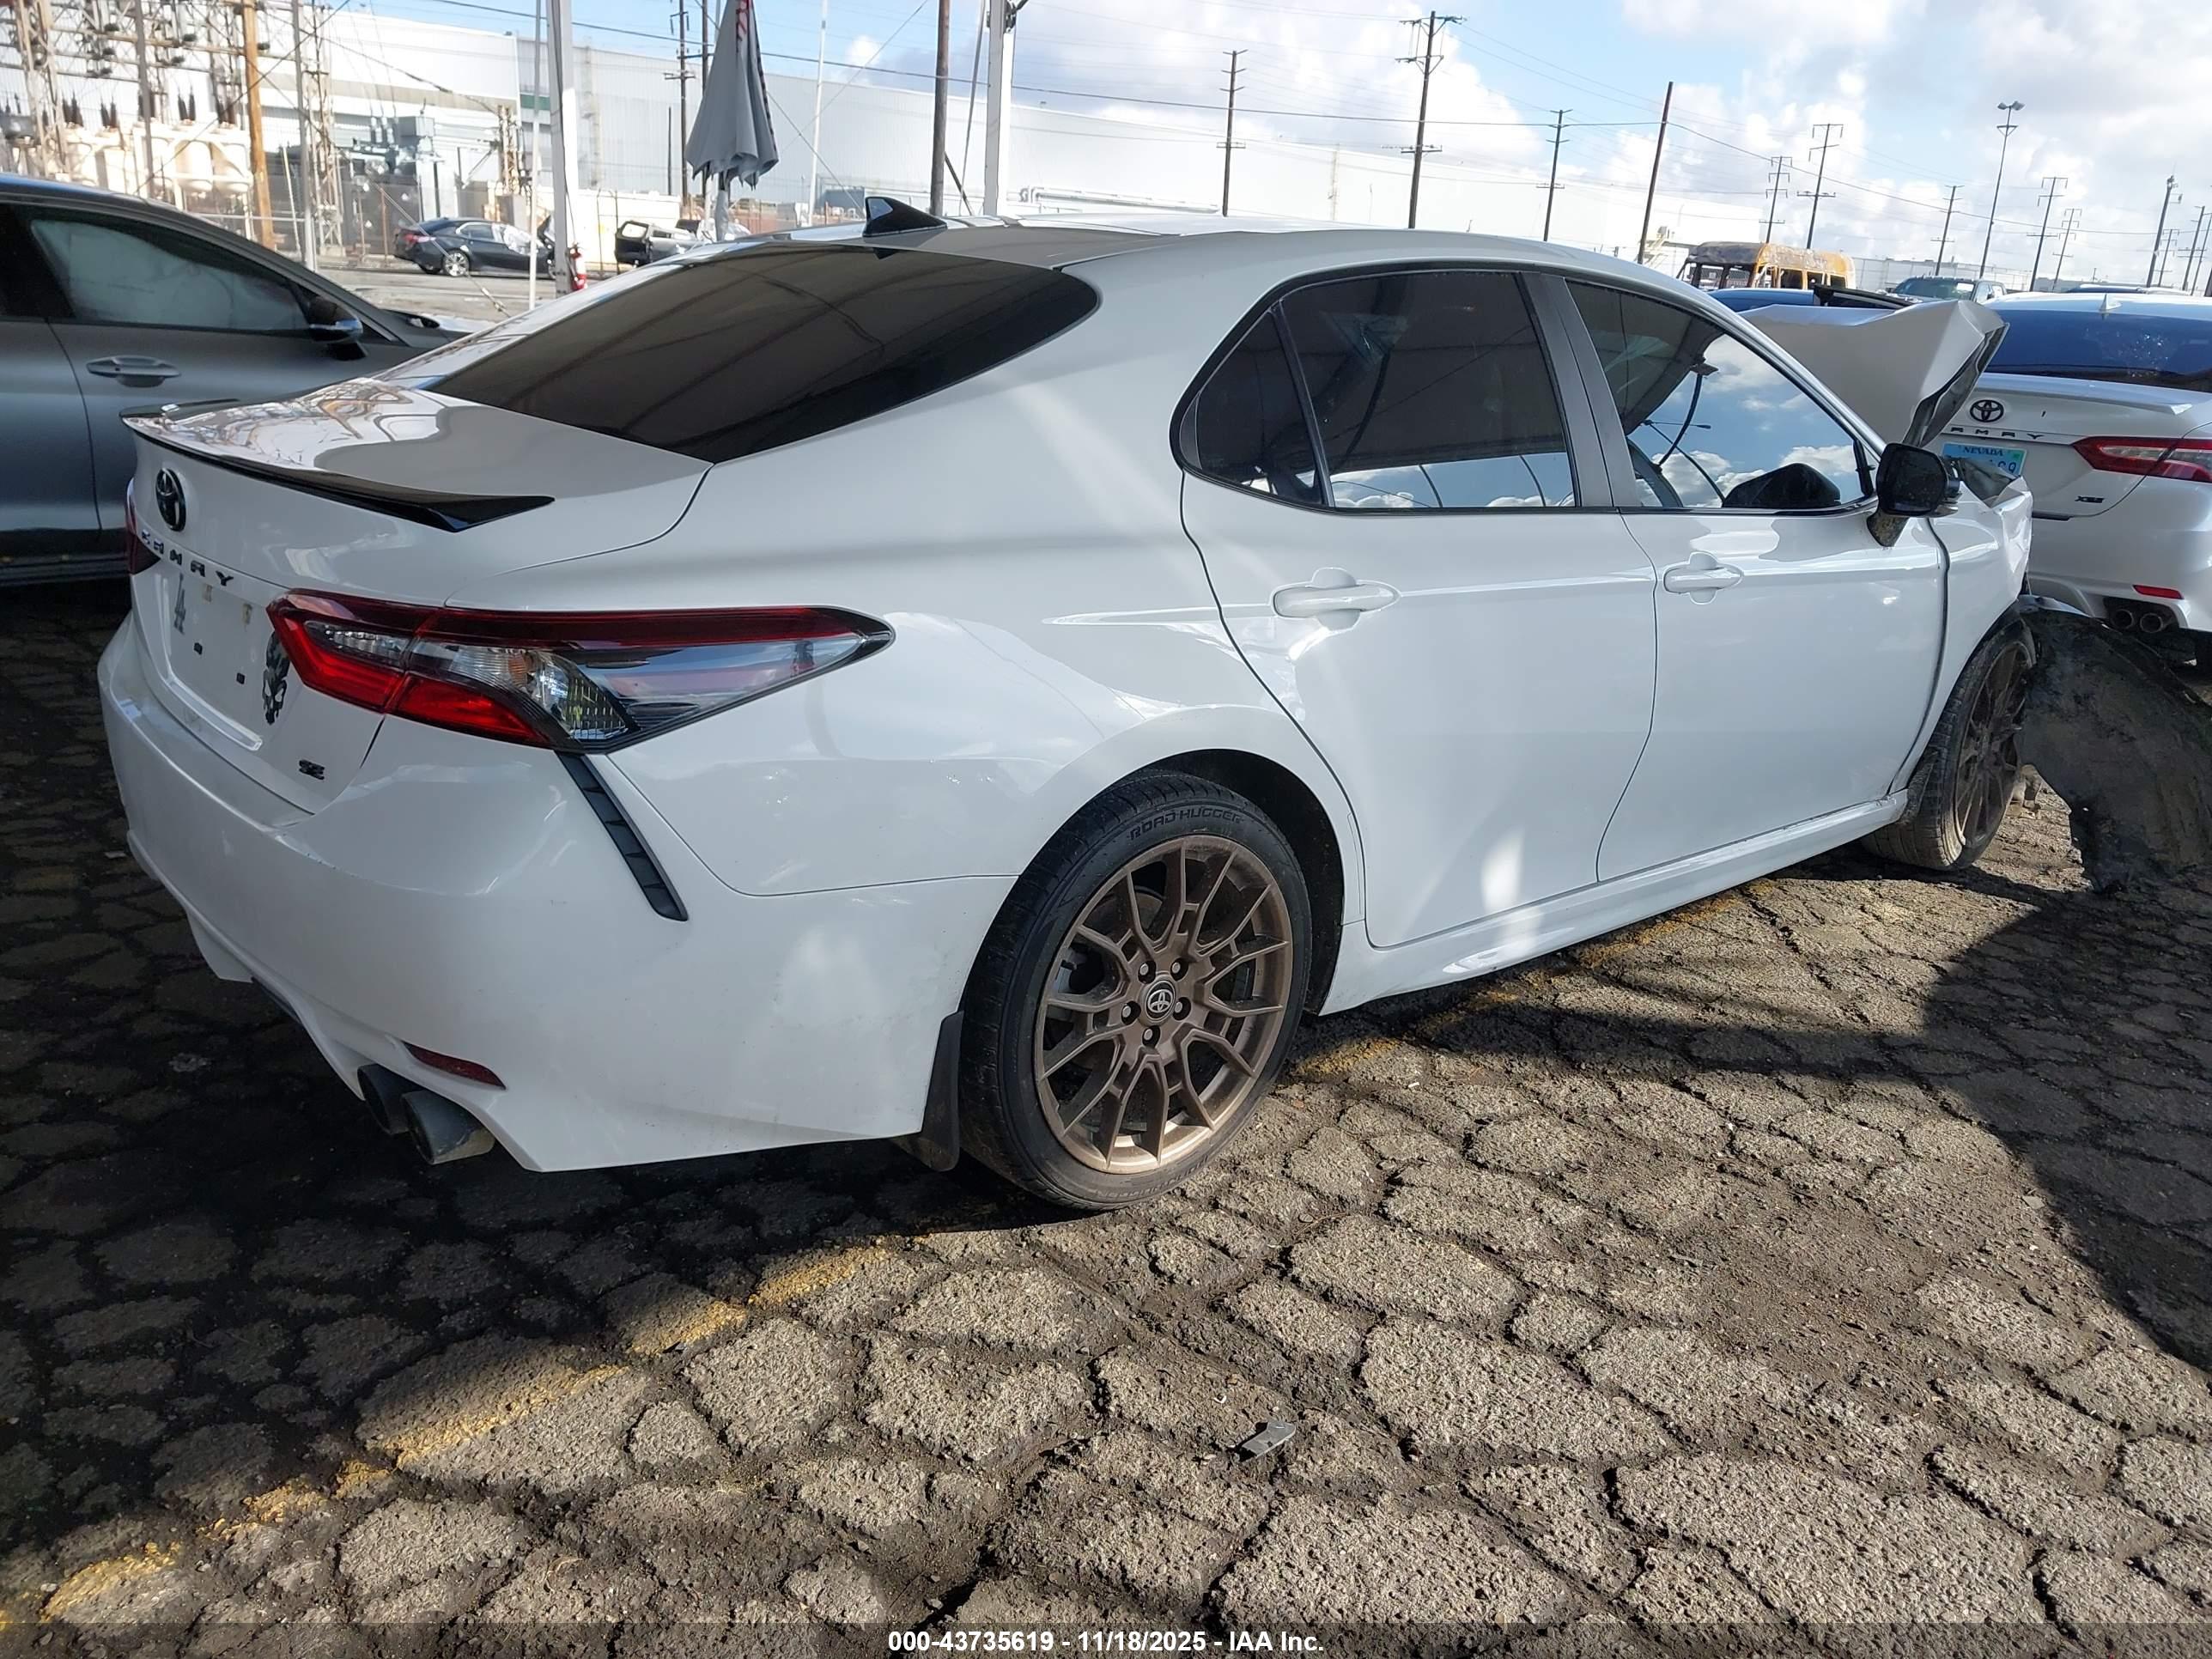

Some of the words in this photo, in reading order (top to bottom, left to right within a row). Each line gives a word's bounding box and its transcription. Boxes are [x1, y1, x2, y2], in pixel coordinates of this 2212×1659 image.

[1950, 426, 2044, 439] AMRY
[1963, 446, 2004, 457] NEVADA
[141, 529, 234, 586] CAMRY
[299, 758, 325, 780] SE
[1129, 811, 1176, 840] ROAD
[1179, 806, 1243, 824] HUGGER
